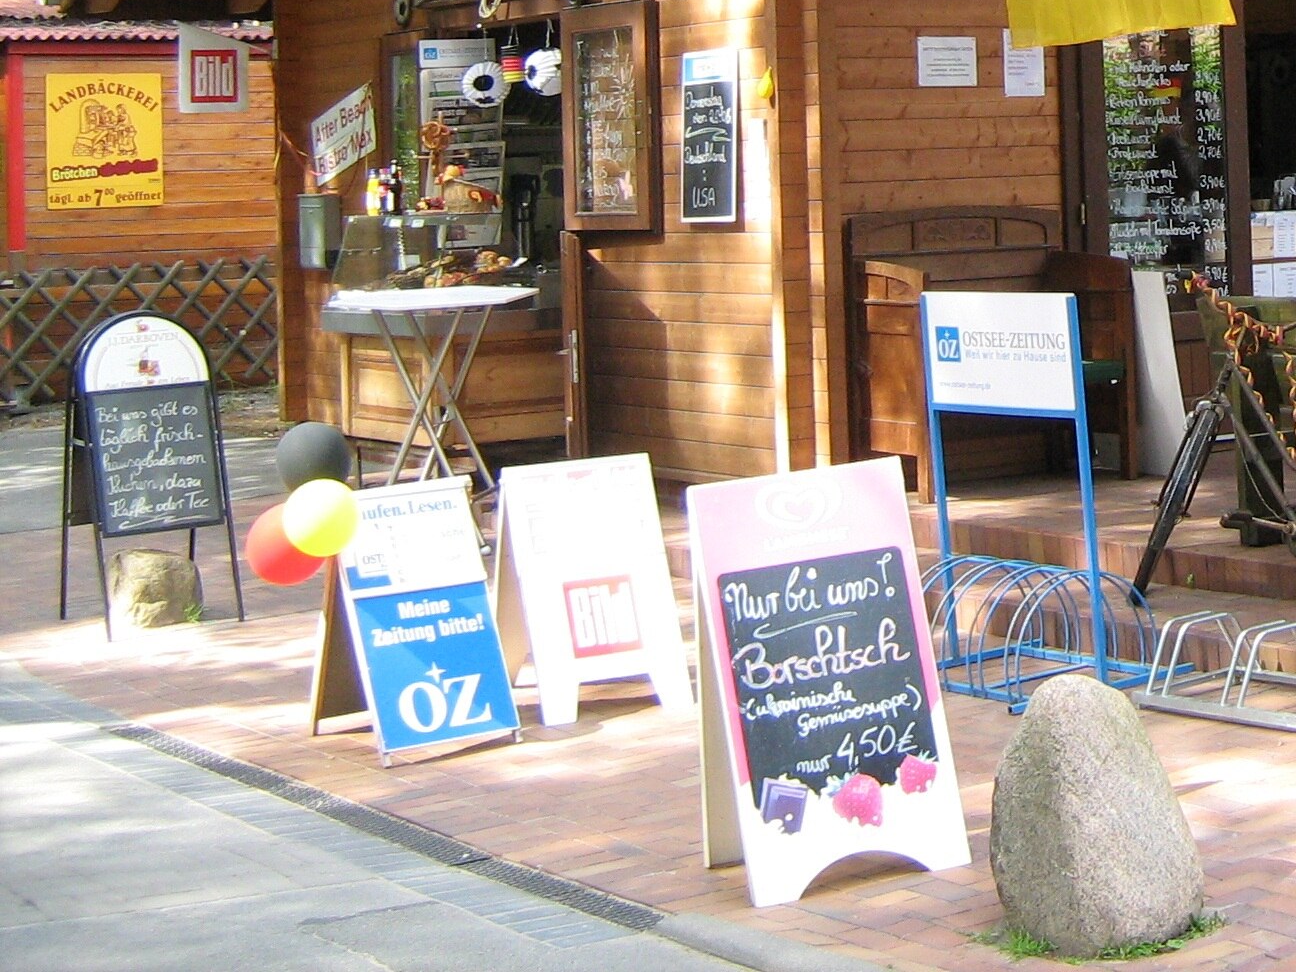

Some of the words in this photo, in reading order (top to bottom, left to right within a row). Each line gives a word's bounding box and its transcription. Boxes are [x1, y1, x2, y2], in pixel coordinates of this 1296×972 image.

[193, 54, 237, 99] Bild
[49, 79, 161, 114] LANDBÄCKEREI
[51, 166, 99, 182] Brötchen
[1199, 175, 1226, 190] 3,90€
[78, 192, 92, 203] ab
[115, 191, 163, 204] geöffnet
[692, 186, 716, 209] USA
[962, 331, 1066, 351] OSTSEE-ZEITUNG
[1024, 351, 1048, 362] Hause
[95, 406, 119, 424] Bei
[121, 410, 148, 421] uns
[150, 400, 179, 428] gibt
[183, 405, 199, 416] es
[100, 424, 150, 455] täglich
[165, 472, 202, 490] dazu
[155, 495, 185, 512] oder
[184, 489, 210, 509] Tee
[725, 581, 781, 623] Nur
[784, 565, 822, 612] bei
[397, 599, 450, 621] Meine
[571, 581, 640, 650] Bild
[371, 621, 436, 649] Zeitung
[439, 614, 485, 637] bitte!
[732, 618, 911, 690] Borschtsch
[796, 752, 830, 774] nur
[836, 721, 918, 771] 4,50€
